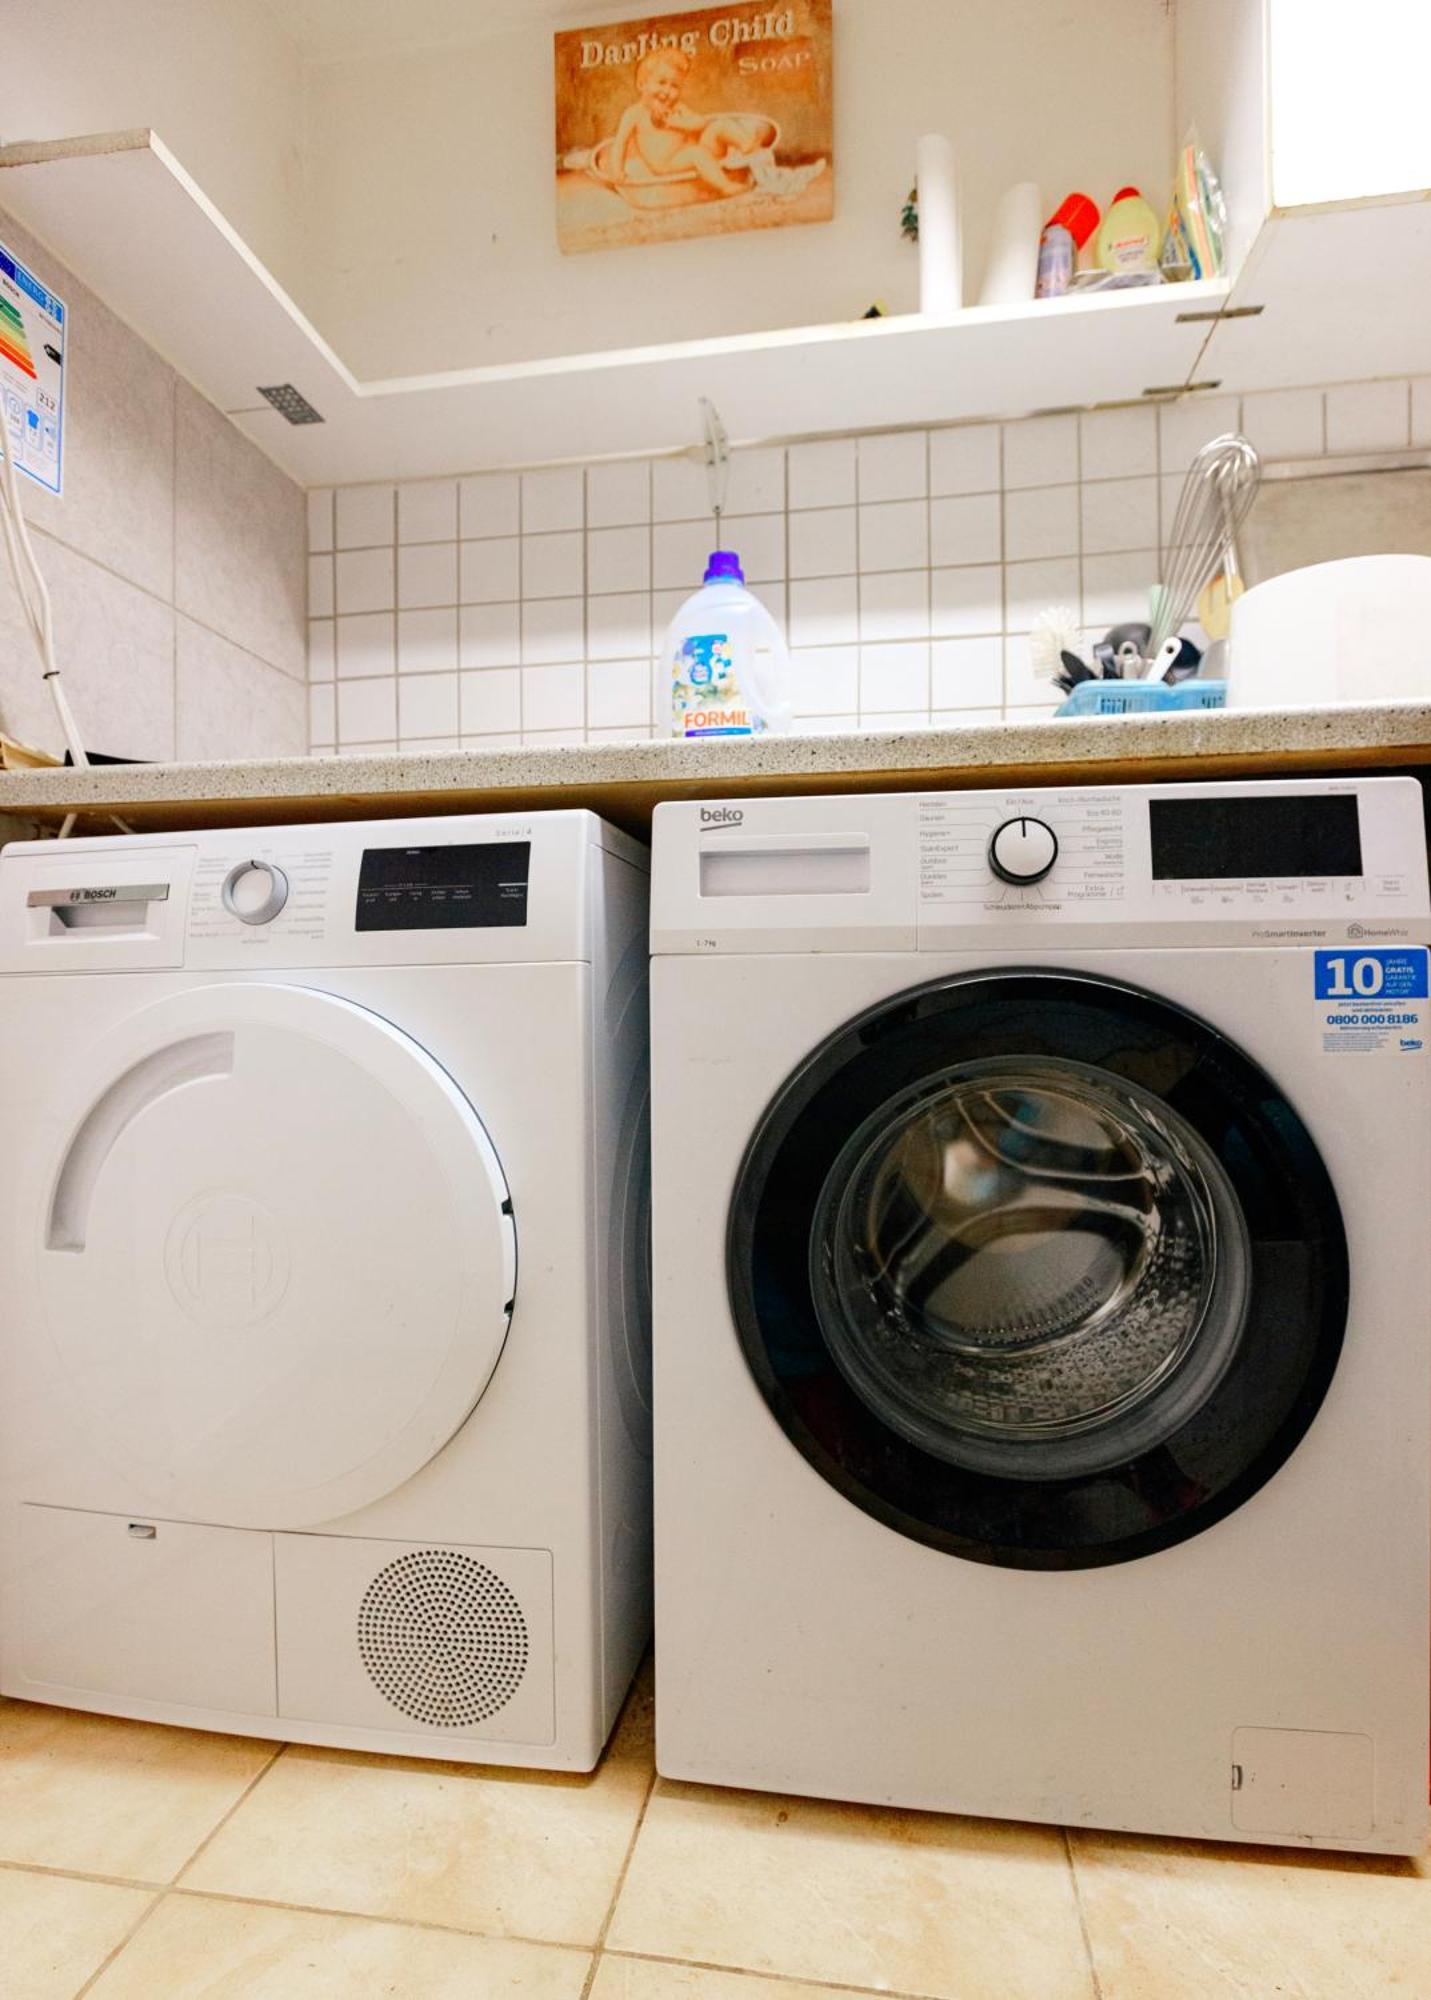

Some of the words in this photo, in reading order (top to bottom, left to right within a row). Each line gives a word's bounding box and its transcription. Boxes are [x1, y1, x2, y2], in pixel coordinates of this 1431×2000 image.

[580, 30, 700, 69] Darling
[708, 9, 794, 47] Child
[738, 51, 812, 76] SOAP
[684, 710, 751, 728] FORMIL
[700, 807, 744, 823] beko
[84, 889, 117, 900] BOSCH
[1326, 957, 1383, 996] 10
[1385, 966, 1414, 974] GRATIS
[1326, 1014, 1359, 1025] 0800
[1361, 1014, 1385, 1025] 000
